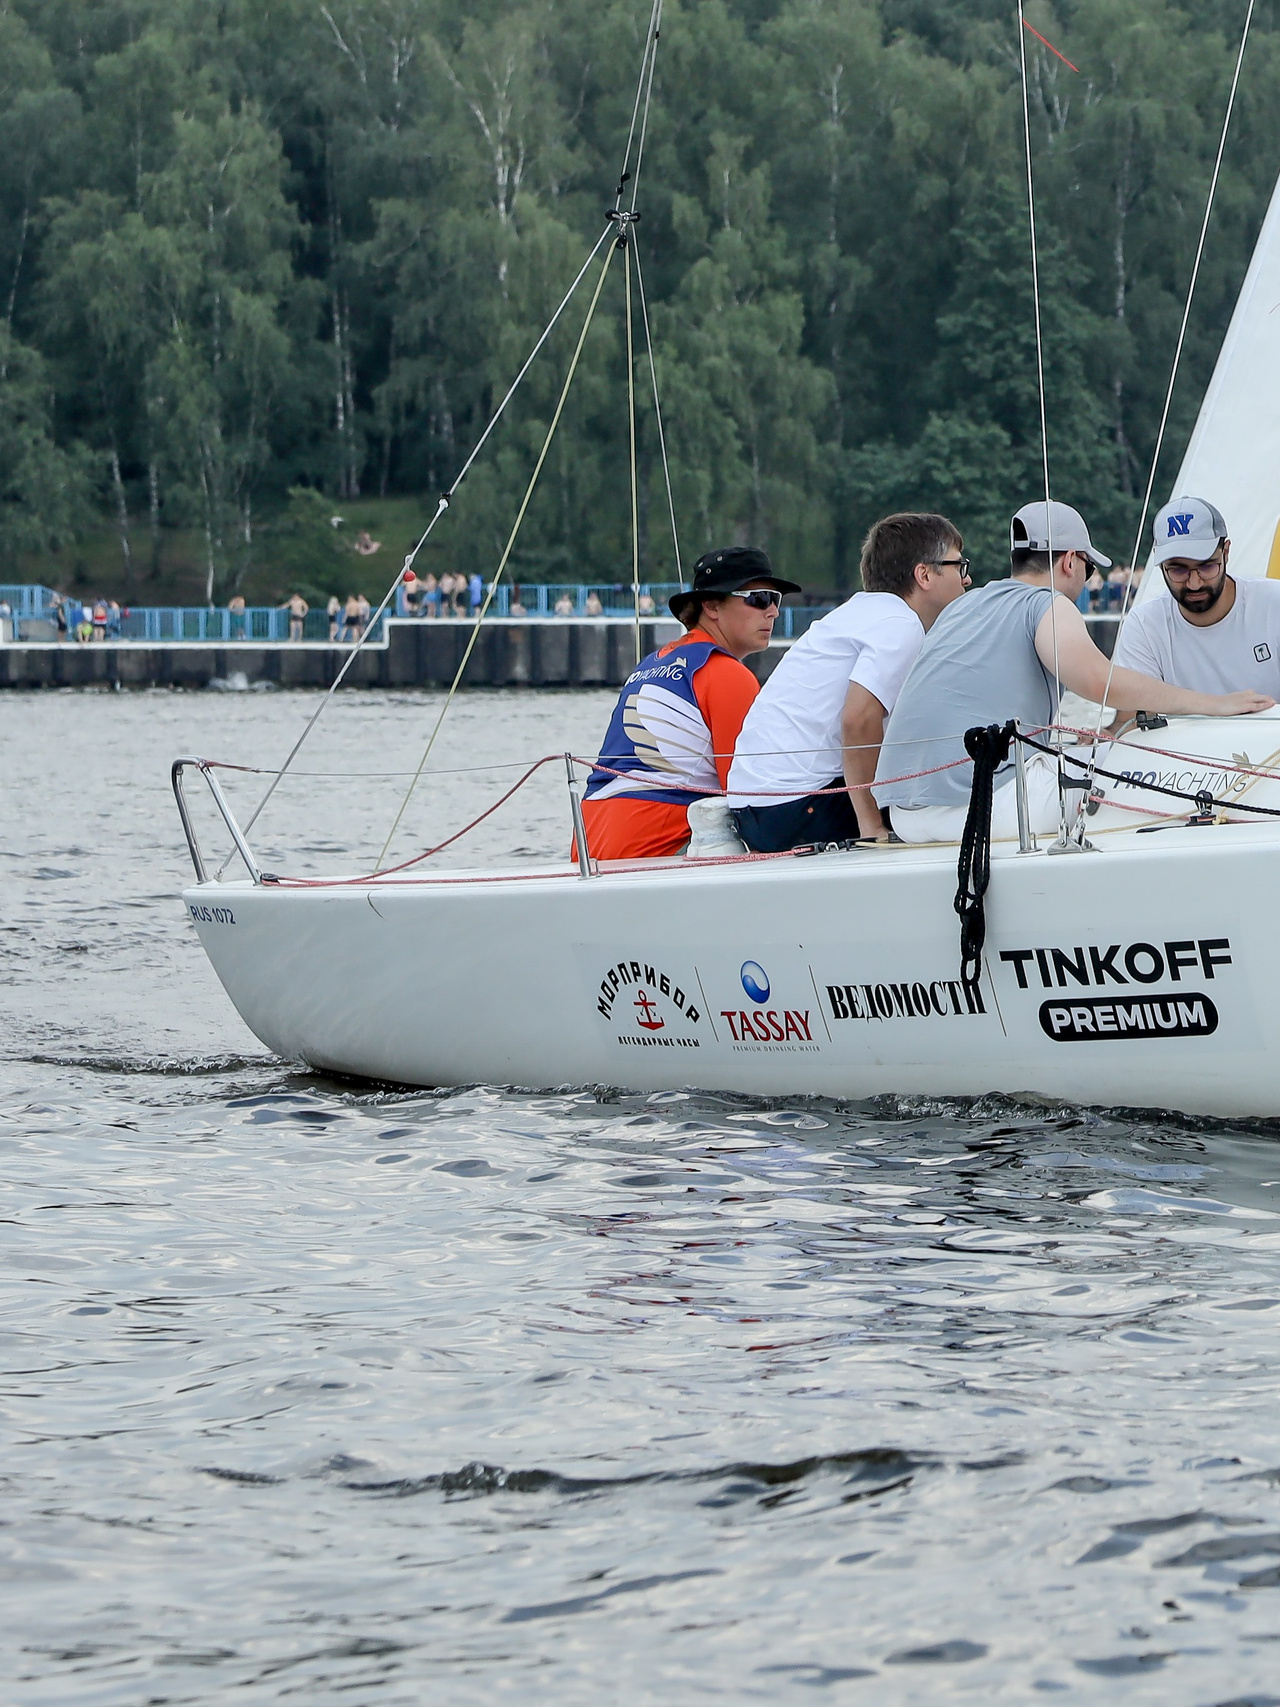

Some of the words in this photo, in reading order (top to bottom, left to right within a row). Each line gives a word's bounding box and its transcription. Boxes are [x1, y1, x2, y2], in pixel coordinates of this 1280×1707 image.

[1167, 514, 1194, 537] NY
[1113, 771, 1249, 792] PROYACHTING
[190, 906, 212, 922] RUS
[212, 908, 236, 924] 1072
[1000, 938, 1232, 989] TINKOFF
[597, 961, 700, 1023] МОРПРИБОР
[826, 980, 987, 1022] ВЕДОМОСТИ
[720, 1010, 813, 1042] TASSAY
[1047, 1000, 1208, 1034] PREMIUM
